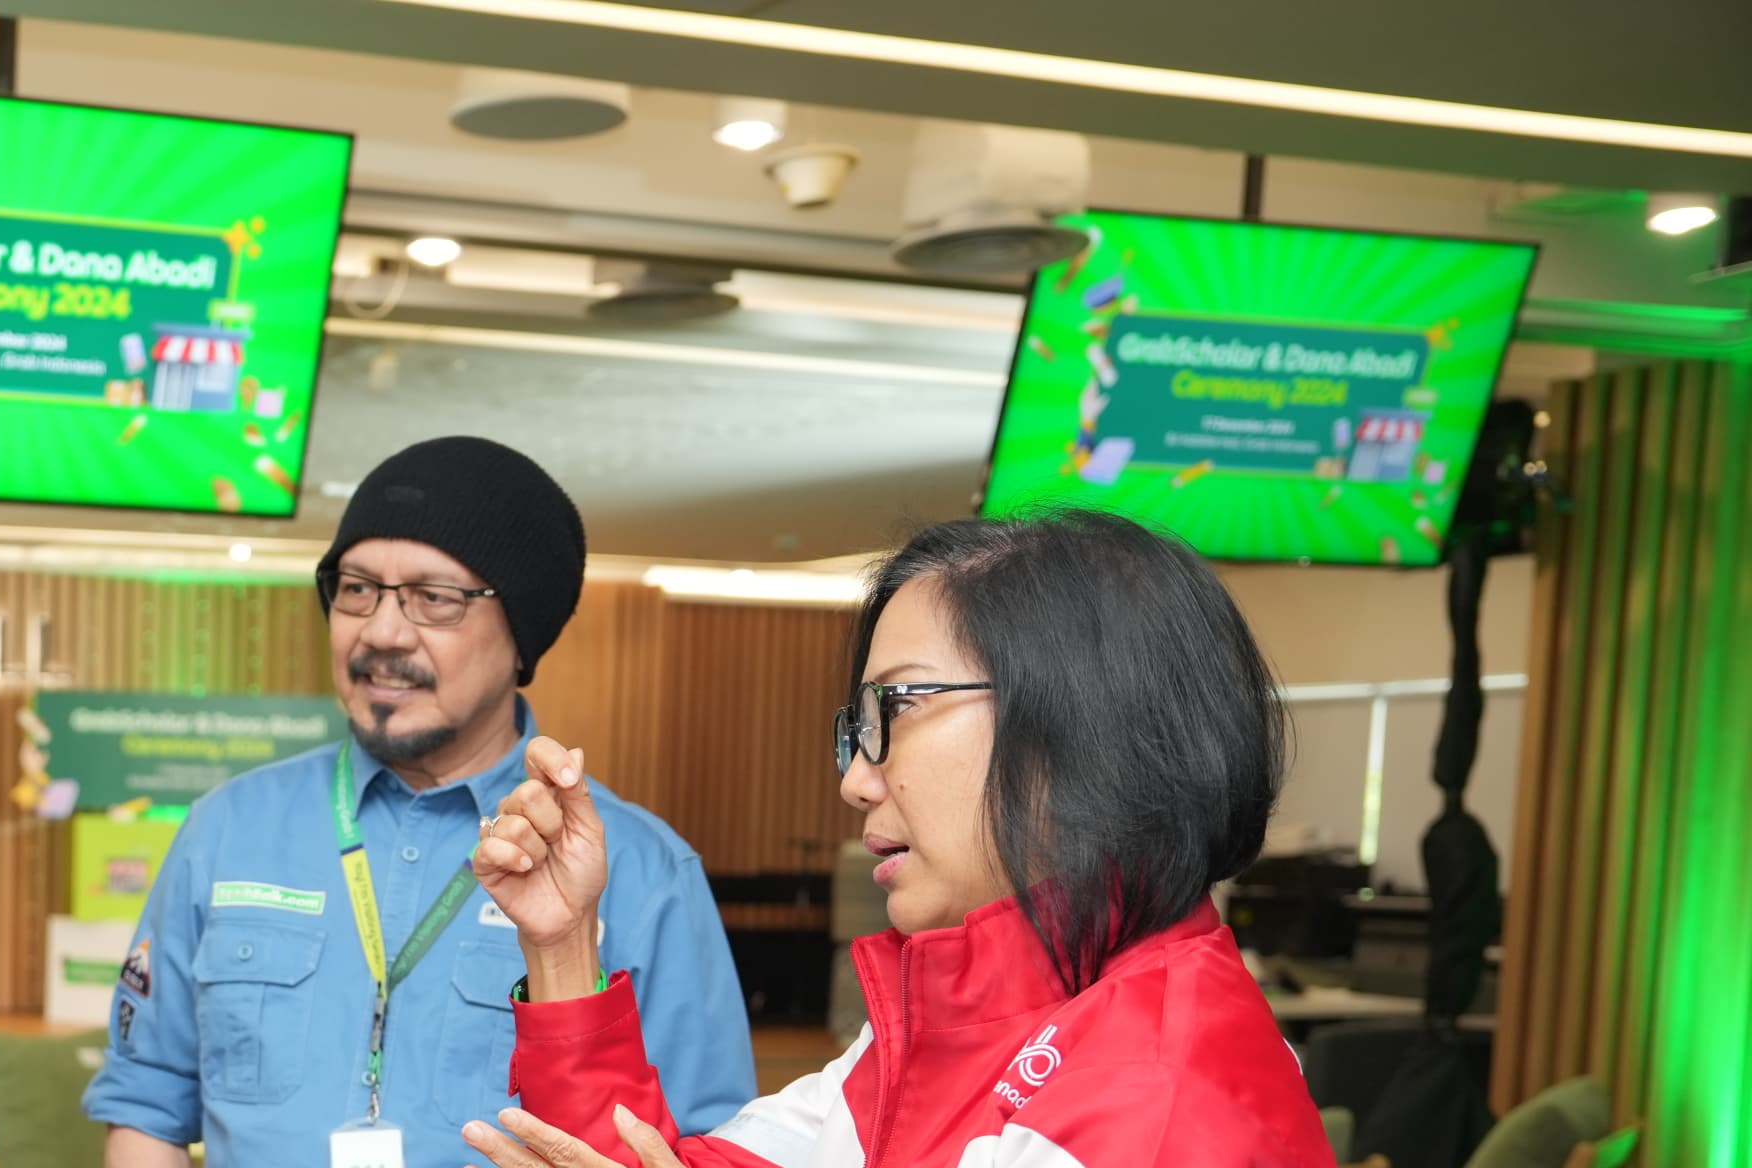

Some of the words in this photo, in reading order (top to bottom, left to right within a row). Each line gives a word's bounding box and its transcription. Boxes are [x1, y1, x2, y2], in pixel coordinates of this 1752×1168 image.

[8, 241, 35, 274] &
[38, 243, 122, 281] Dana
[124, 252, 217, 289] Abadi
[52, 282, 132, 319] 2024
